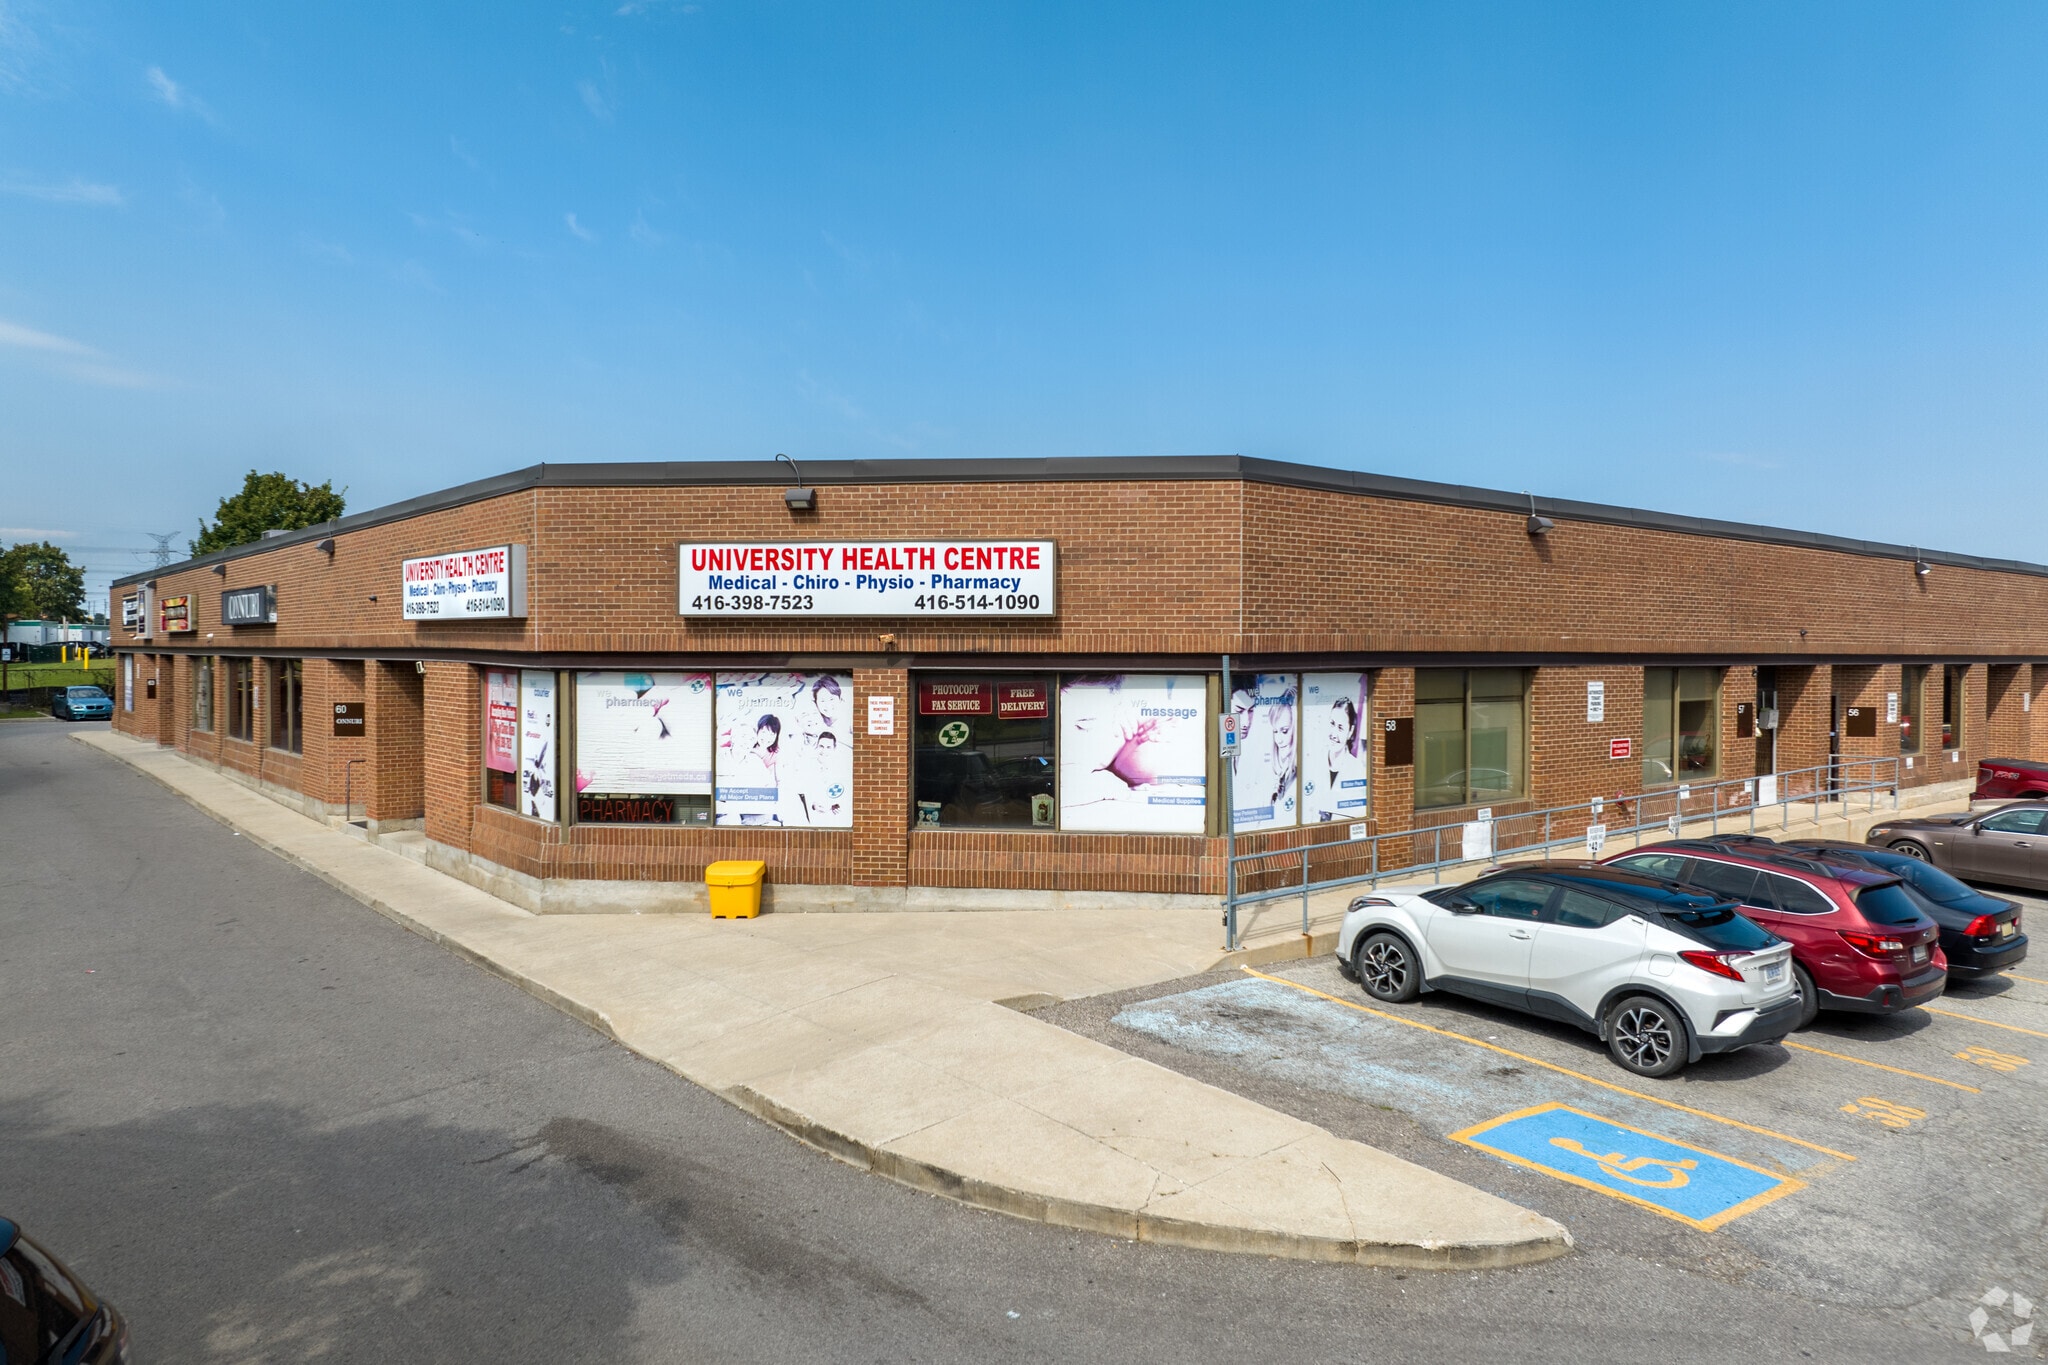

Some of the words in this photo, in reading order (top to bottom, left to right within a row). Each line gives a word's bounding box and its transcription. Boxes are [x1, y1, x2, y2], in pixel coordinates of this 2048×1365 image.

[691, 547, 834, 571] UNIVERSITY
[842, 547, 935, 571] HEALTH
[943, 547, 1040, 570] CENTRE
[405, 560, 444, 582] UNIVERSITY
[445, 555, 473, 578] HEALTH
[475, 551, 504, 576] CENTRE
[409, 583, 429, 597] Medical
[433, 582, 445, 595] Chiro
[448, 581, 467, 597] Physio
[472, 579, 498, 594] Pharmacy
[708, 575, 777, 590] Medical
[793, 575, 839, 590] Chiro
[856, 574, 914, 593] Physio
[931, 574, 1021, 593] Pharmacy
[228, 593, 259, 619] ONNURI
[406, 601, 439, 614] 416-398-7523
[466, 597, 505, 612] 416-514-1090
[692, 595, 814, 611] 416-398-7523
[914, 594, 1040, 610] 416-514-1090
[597, 689, 612, 697] we
[727, 689, 743, 697] we
[932, 684, 979, 695] PHOTOCOPY
[1010, 689, 1035, 698] FREE
[1248, 688, 1260, 696] we
[1308, 686, 1319, 694] we
[606, 696, 662, 709] pharmacy
[738, 697, 797, 710] pharmacy
[932, 700, 946, 711] FAX
[947, 700, 980, 710] SERVICE
[1001, 701, 1045, 711] DELIVERY
[1131, 699, 1147, 707] we
[1254, 696, 1295, 708] pharmacy
[335, 705, 347, 713] 60
[1140, 708, 1197, 719] massage
[1738, 705, 1745, 713] 57
[1385, 720, 1396, 731] 58
[580, 800, 674, 823] PHARMACY
[1839, 1096, 1927, 1128] 58
